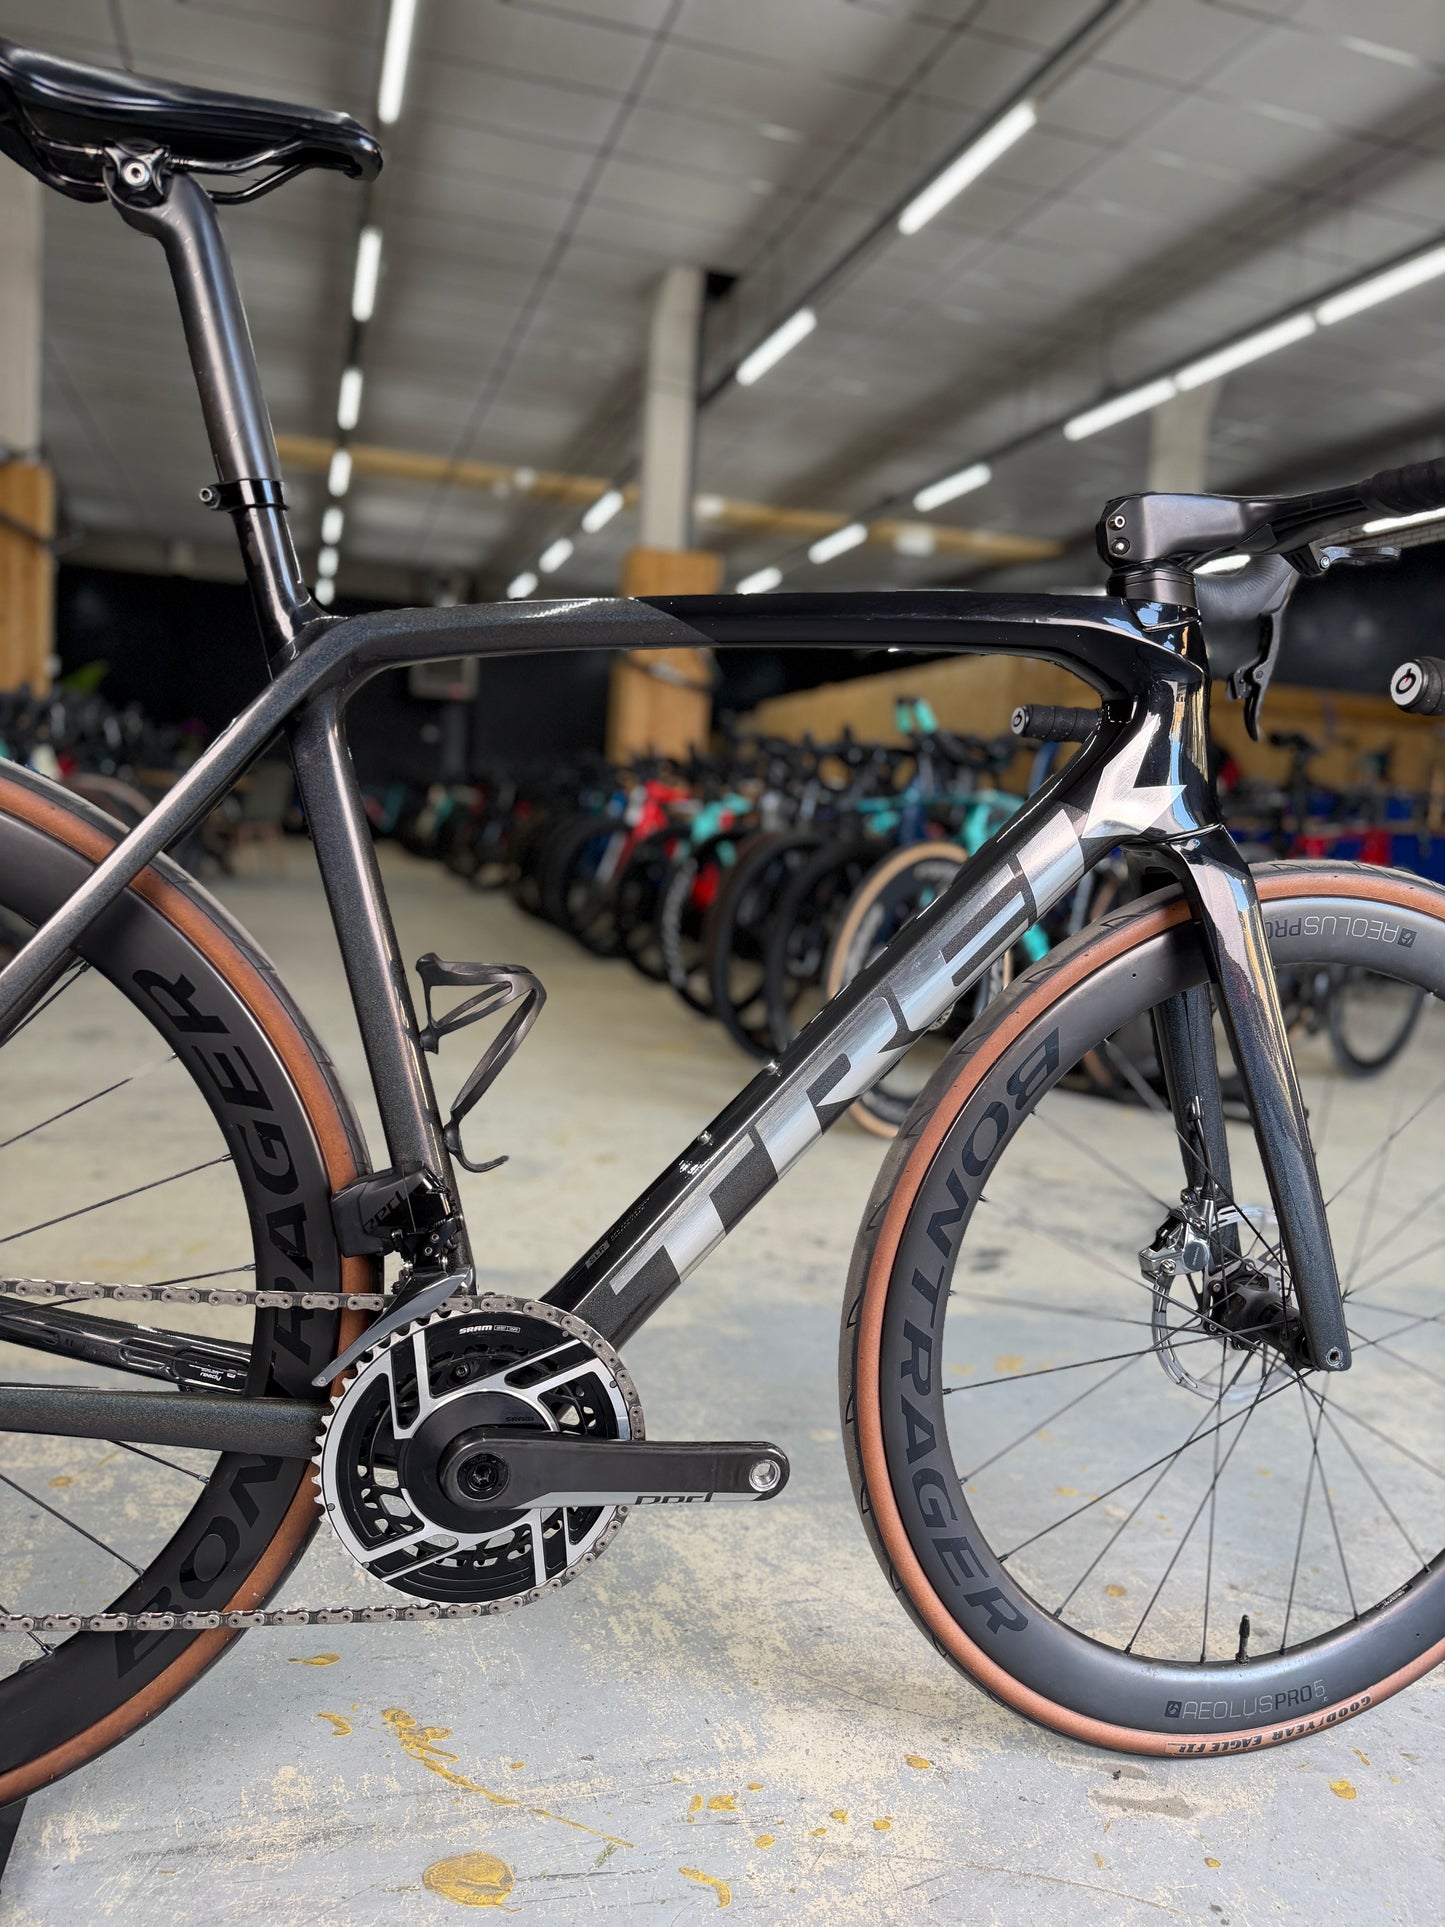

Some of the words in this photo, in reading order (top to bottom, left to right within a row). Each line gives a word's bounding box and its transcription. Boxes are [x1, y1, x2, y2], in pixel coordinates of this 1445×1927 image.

[609, 714, 1187, 1296] TREK
[459, 1325, 493, 1335] SRAM
[901, 1027, 1060, 1634] BONTRAGER
[1211, 1735, 1263, 1752] EAGLE
